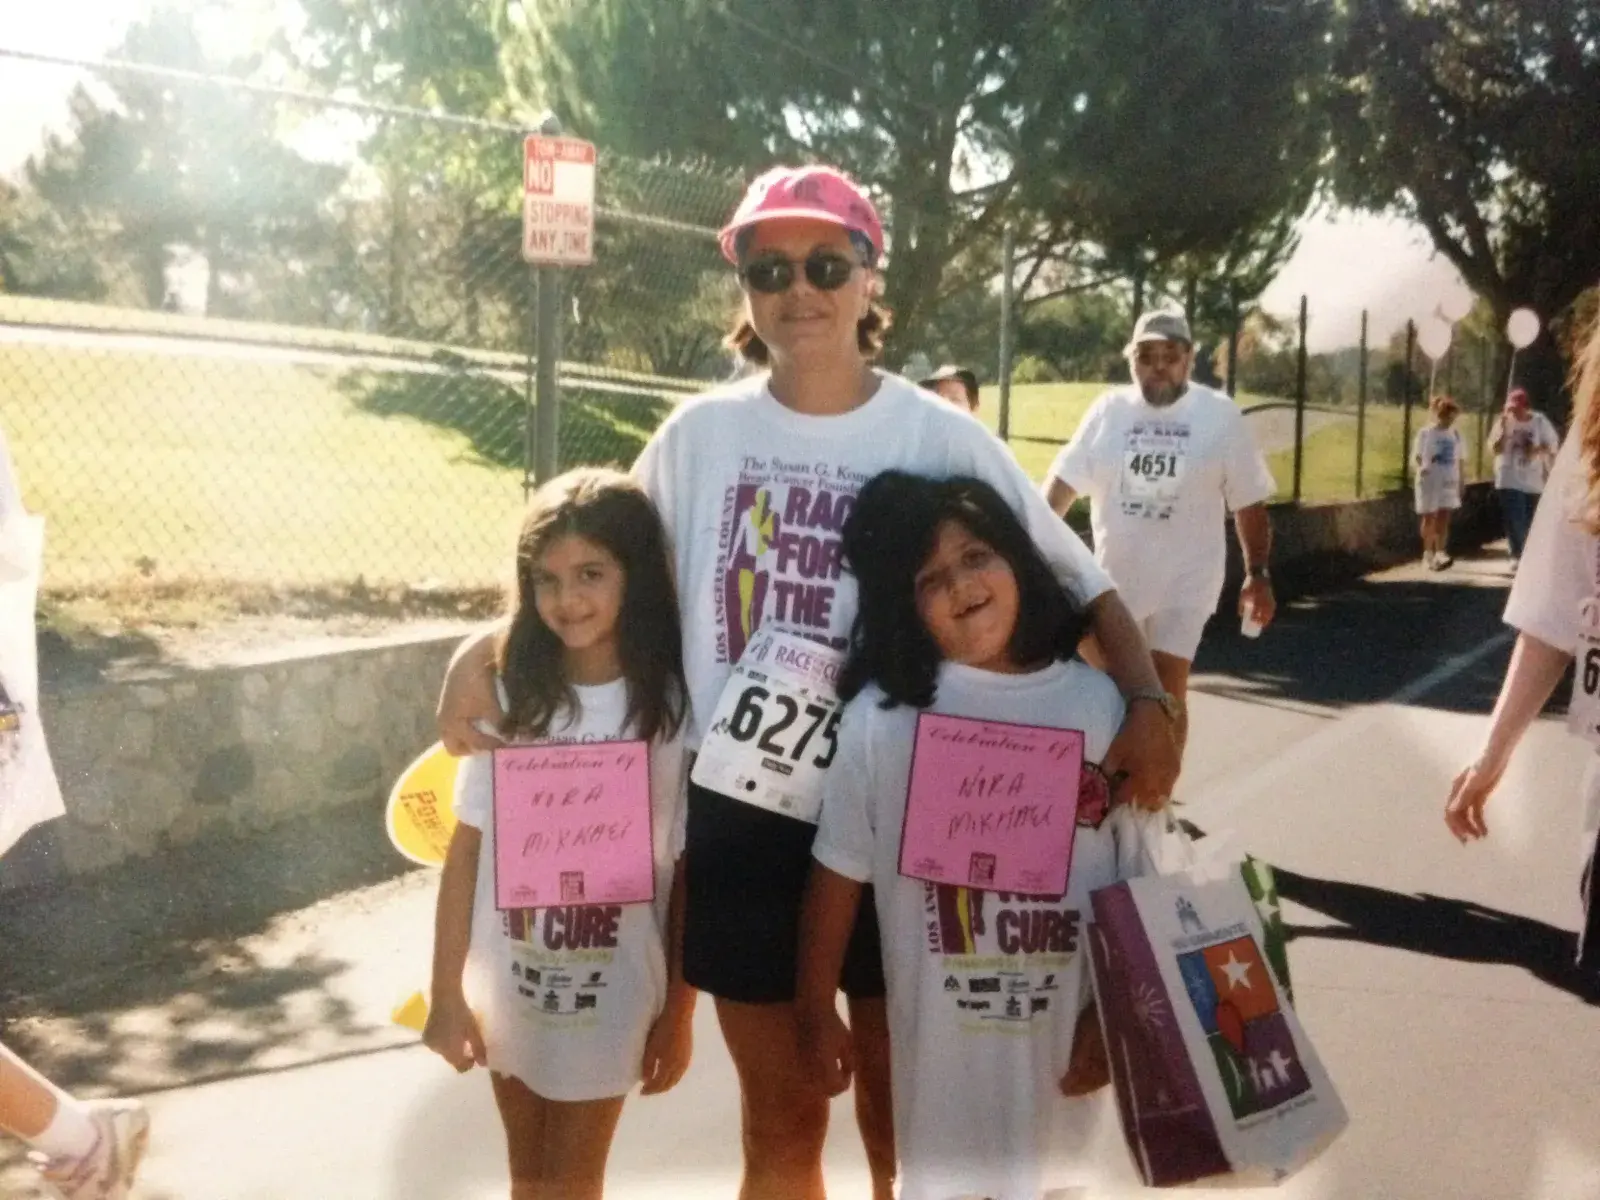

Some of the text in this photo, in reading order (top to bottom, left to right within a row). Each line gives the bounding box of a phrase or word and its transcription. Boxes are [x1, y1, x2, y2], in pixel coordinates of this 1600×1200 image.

[527, 159, 552, 191] NO
[530, 229, 557, 251] ANY
[742, 457, 766, 470] The
[772, 457, 810, 474] Susan
[837, 465, 869, 484] Kom
[817, 478, 857, 493] Found
[1130, 453, 1177, 478] 4651
[783, 486, 858, 533] RAC
[776, 532, 843, 581] FOR
[773, 580, 835, 629] THE
[715, 631, 728, 664] LOS
[775, 645, 811, 672] RACE
[823, 662, 842, 683] CU
[1584, 647, 1600, 695] 6
[728, 686, 842, 769] 6275
[543, 904, 622, 951] CURE
[996, 909, 1081, 955] CURE
